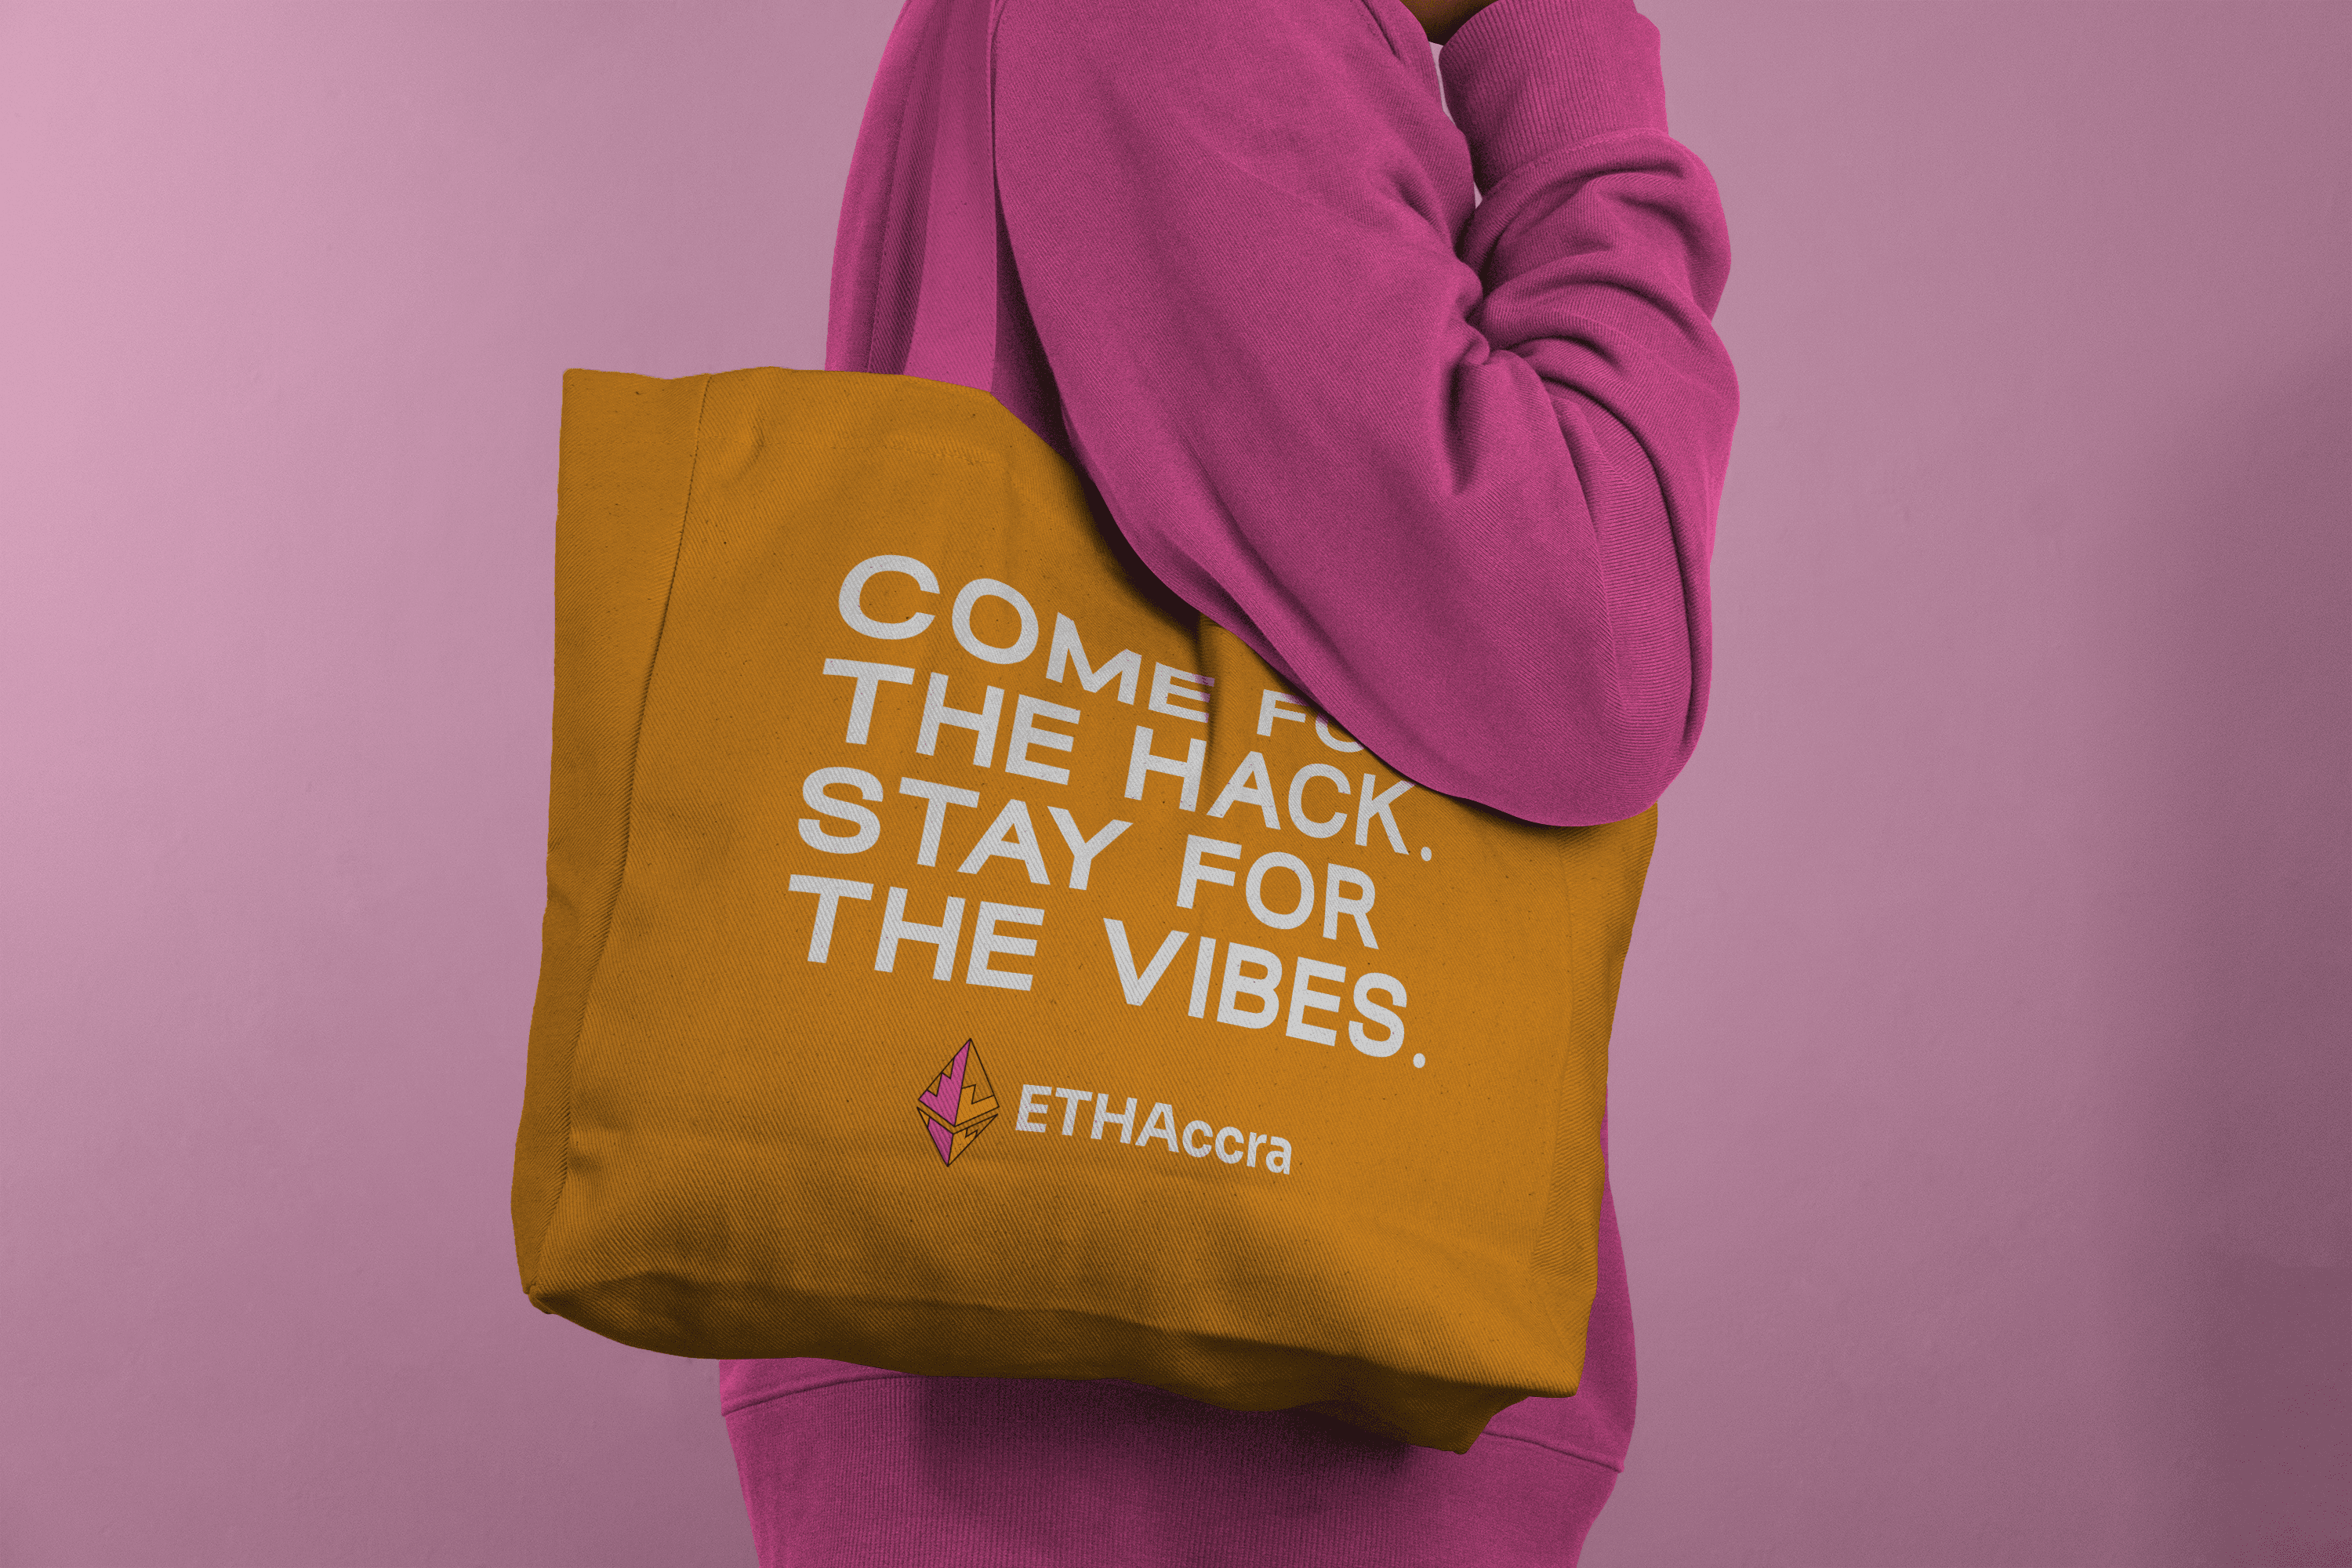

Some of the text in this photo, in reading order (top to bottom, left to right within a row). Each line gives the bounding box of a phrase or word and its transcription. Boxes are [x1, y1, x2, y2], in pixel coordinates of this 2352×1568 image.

[838, 554, 1215, 724] COME
[822, 658, 1432, 862] THE HACK.
[797, 766, 1380, 950] STAY FOR
[787, 873, 1426, 1069] THE VIBES.
[1014, 1083, 1293, 1175] ETHAccra
